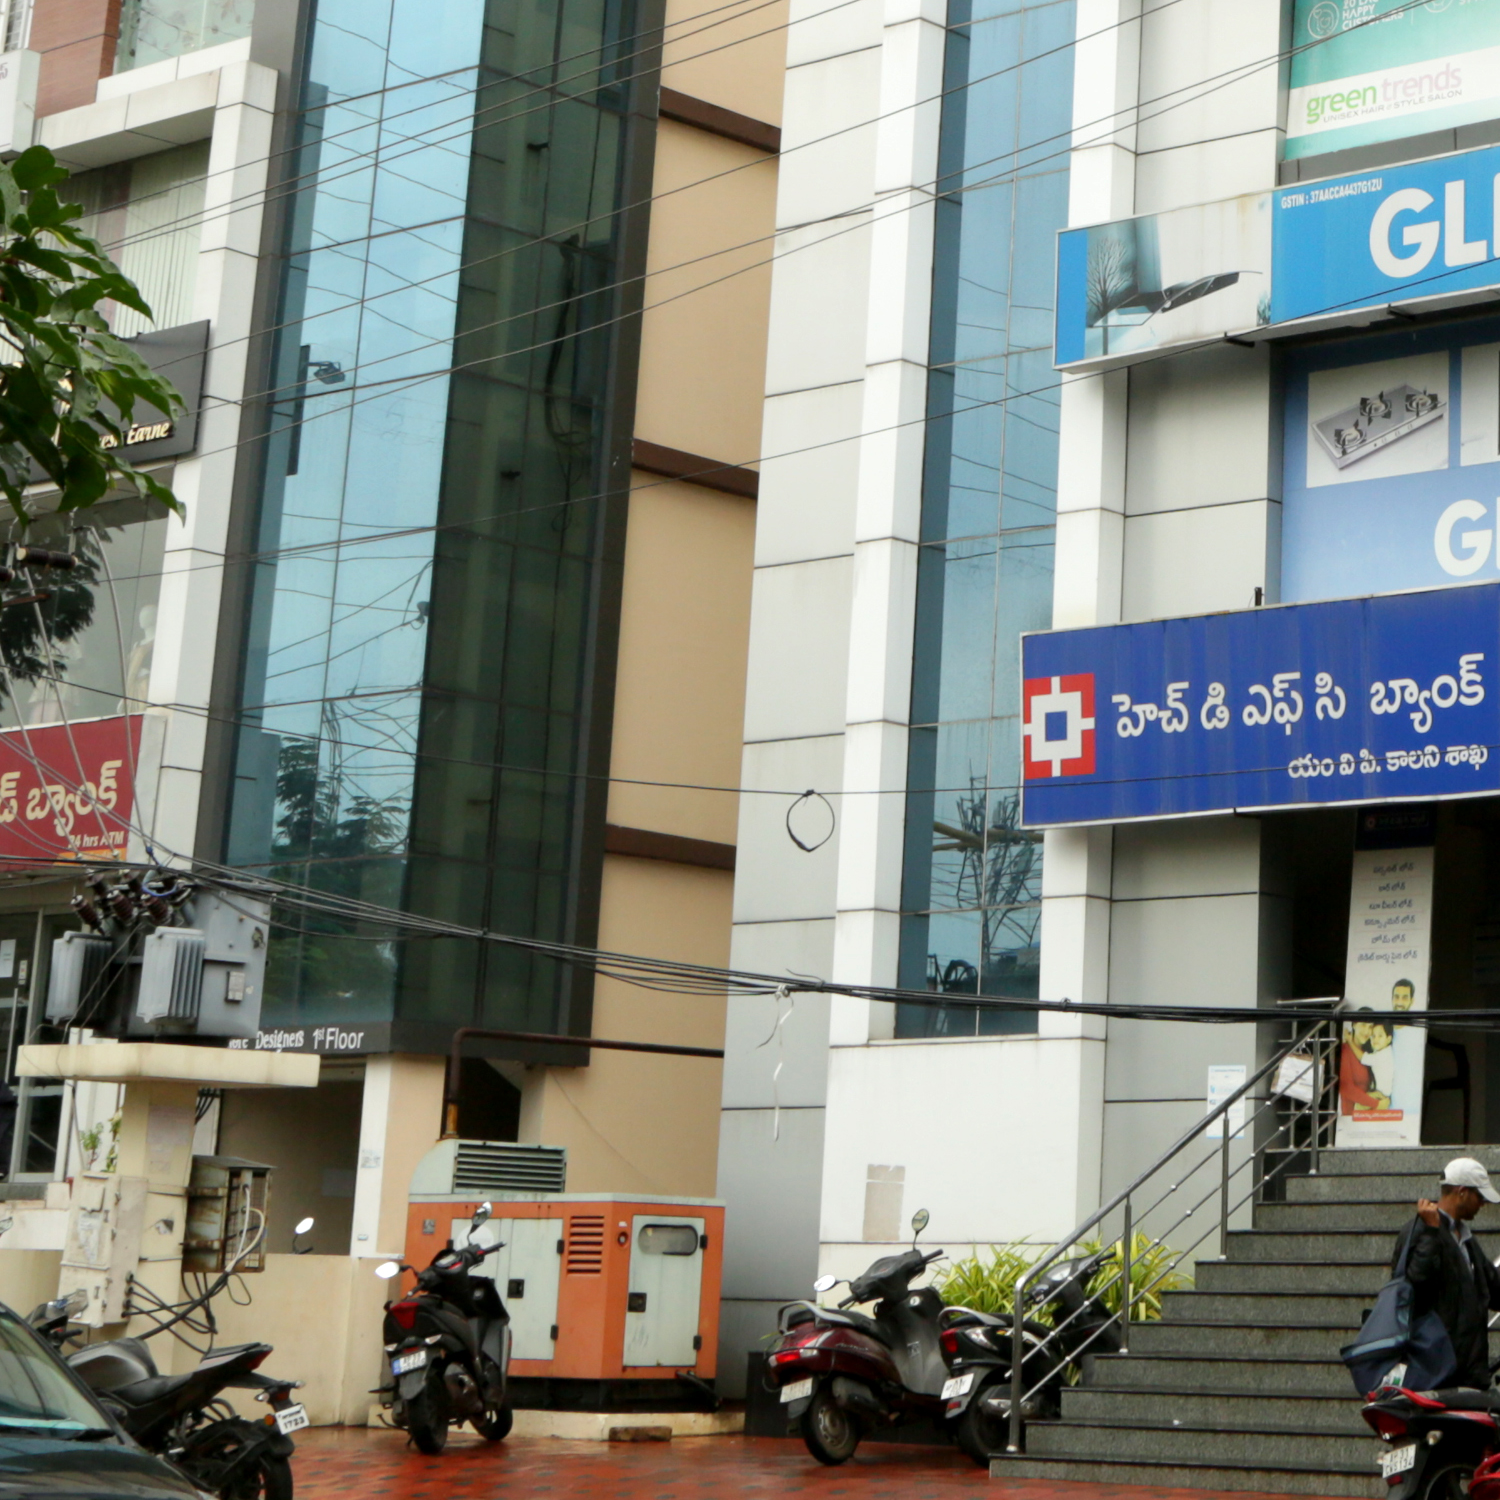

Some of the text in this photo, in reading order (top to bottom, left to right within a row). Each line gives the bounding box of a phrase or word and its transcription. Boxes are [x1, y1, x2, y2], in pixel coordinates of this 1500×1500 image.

[1342, 3, 1376, 21] HAPPY
[1306, 62, 1463, 125] green trends
[1323, 110, 1359, 124] UNISEX
[1361, 104, 1386, 116] HAIR
[1393, 96, 1426, 110] STYLE
[1427, 88, 1463, 102] SALON
[1281, 192, 1305, 209] GSTIN
[1112, 652, 1486, 738] హెచ్ డి ఎఫ్ సి బ్యాంక్
[26, 759, 122, 837] బ్యాంక్
[82, 834, 100, 848] hrs
[100, 830, 125, 846] ATM
[255, 1029, 305, 1053] Designers
[325, 1027, 365, 1050] Floor
[283, 1416, 305, 1430] 1723
